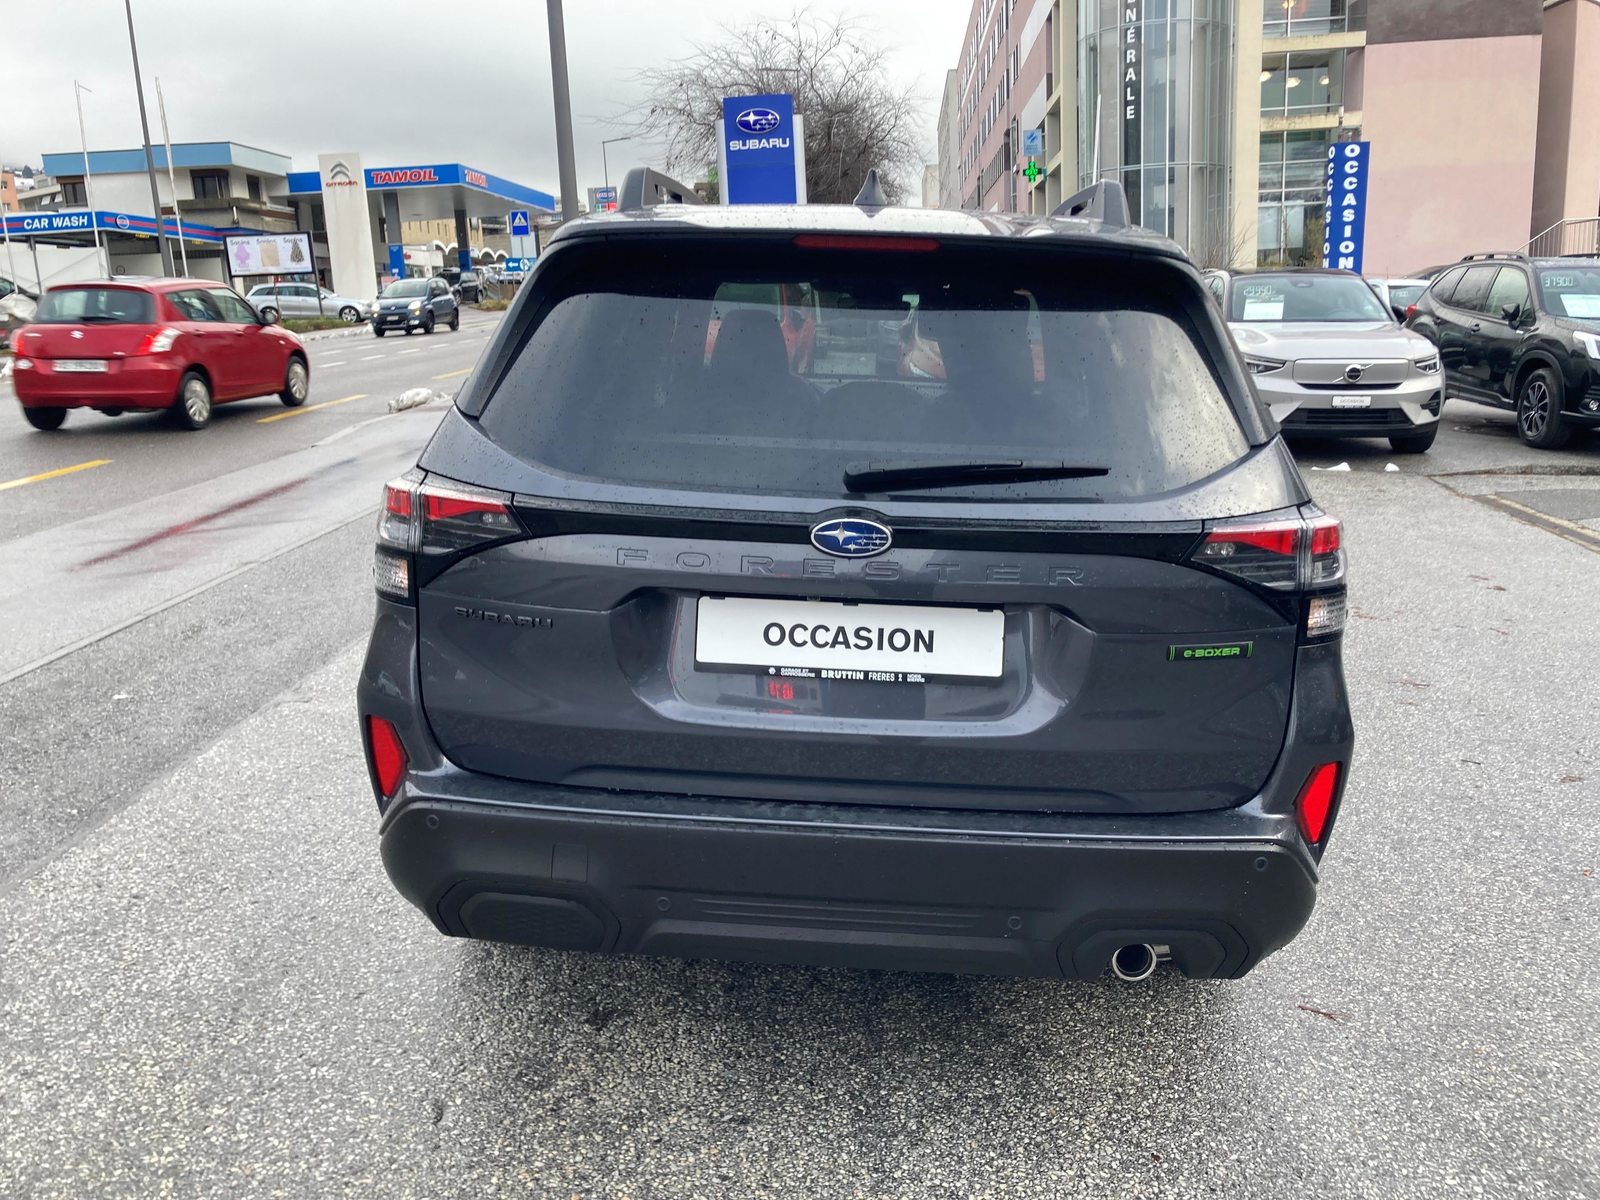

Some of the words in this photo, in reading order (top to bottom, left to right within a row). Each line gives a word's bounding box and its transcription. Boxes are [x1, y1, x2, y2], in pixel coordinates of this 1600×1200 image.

[1125, 0, 1137, 119] NÉRALE
[729, 137, 790, 151] SUBARU
[371, 168, 439, 185] TAMOIL
[1338, 143, 1361, 270] OCCASION
[23, 218, 49, 230] CAR
[52, 215, 88, 228] WASH
[615, 547, 1085, 587] FORESTER
[454, 606, 554, 629] SUBARU
[762, 621, 935, 654] OCCASION
[821, 669, 864, 680] BRUTTIN
